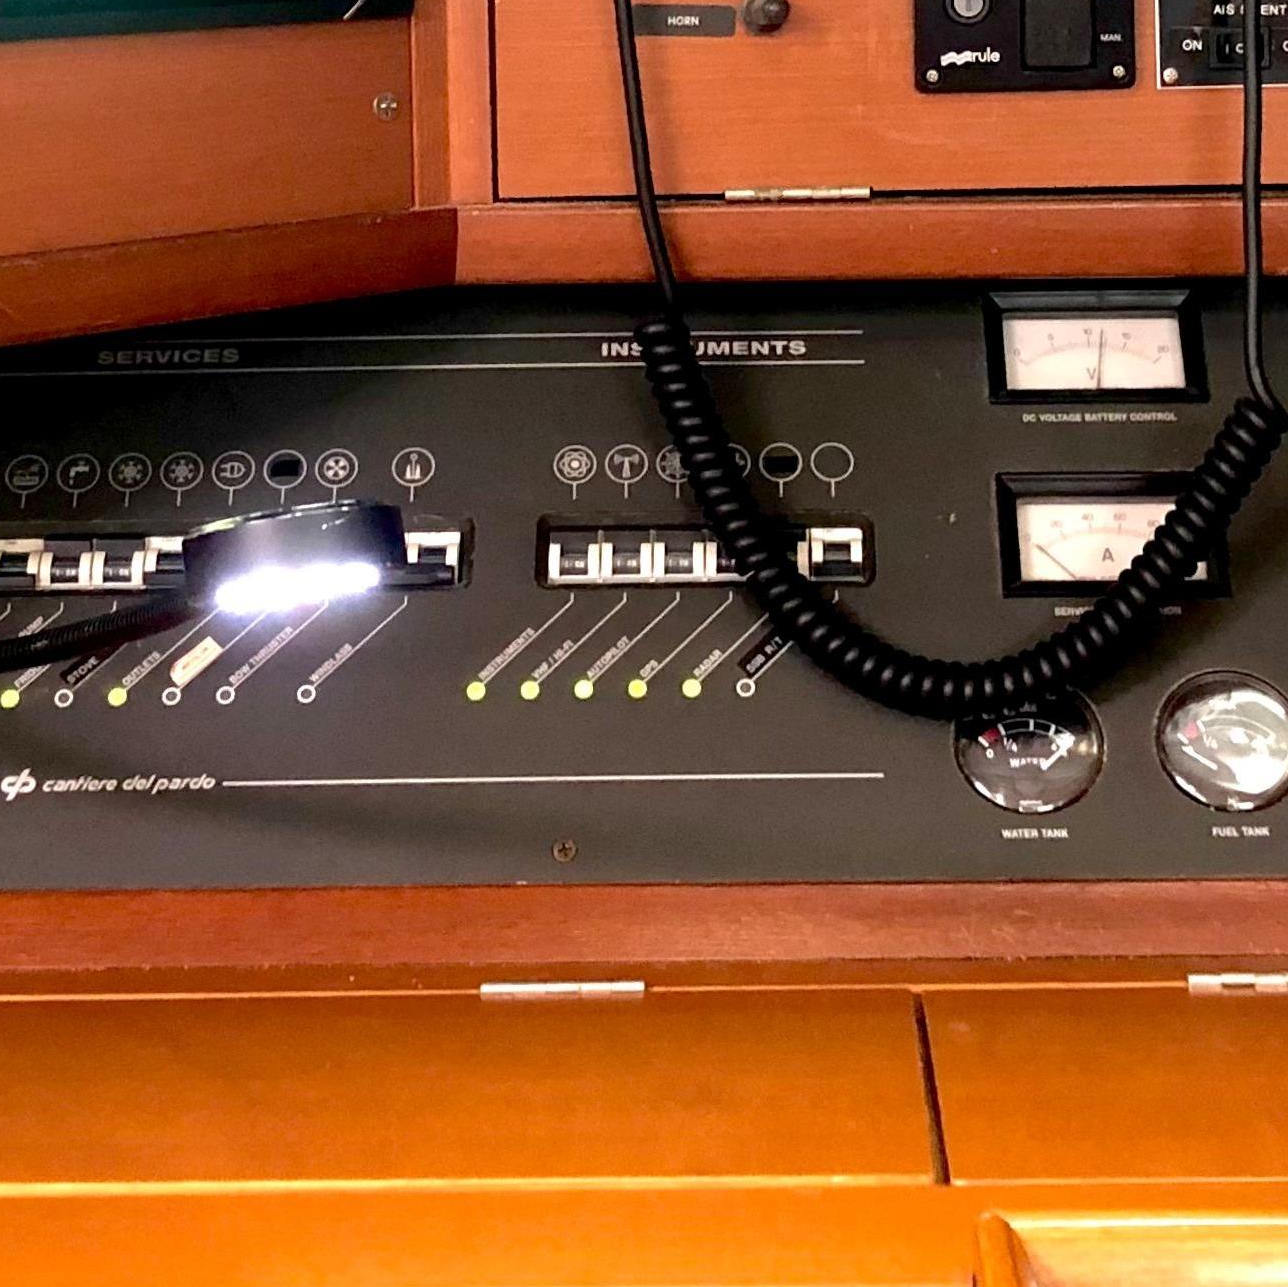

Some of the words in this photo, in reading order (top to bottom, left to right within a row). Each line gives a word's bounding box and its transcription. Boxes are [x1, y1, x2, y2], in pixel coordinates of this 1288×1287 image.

[1213, 4, 1235, 16] AIS
[667, 15, 700, 26] HORN
[1182, 39, 1203, 51] ON
[969, 46, 1001, 64] rule
[98, 348, 240, 365] SERVICES
[601, 339, 807, 357] INSUMENTS
[1085, 367, 1097, 381] V
[1022, 413, 1037, 423] DC
[1039, 412, 1082, 423] VOLTAGE
[1084, 412, 1128, 423] BATTERY
[1129, 411, 1178, 422] CONTROL
[1101, 547, 1115, 563] A
[228, 663, 252, 685] BOW
[249, 625, 295, 667] THRUSTER
[308, 642, 354, 683] WINDLASS
[477, 626, 536, 681] INSTRUMENTS
[585, 635, 632, 679] AUTOPILOT
[745, 653, 766, 675] SSB
[765, 635, 784, 657] R/T
[66, 654, 99, 685] STOVE
[121, 650, 162, 686] OUTLETS
[530, 661, 549, 679] VHF
[639, 658, 660, 679] GPS
[692, 648, 723, 678] RADAR
[42, 775, 118, 793] cantiere
[122, 773, 156, 791] del
[150, 772, 216, 795] pardo
[1001, 827, 1039, 839] WATER
[1041, 827, 1069, 839] TANK
[1212, 826, 1239, 838] FUEL
[1241, 825, 1270, 837] TANK
